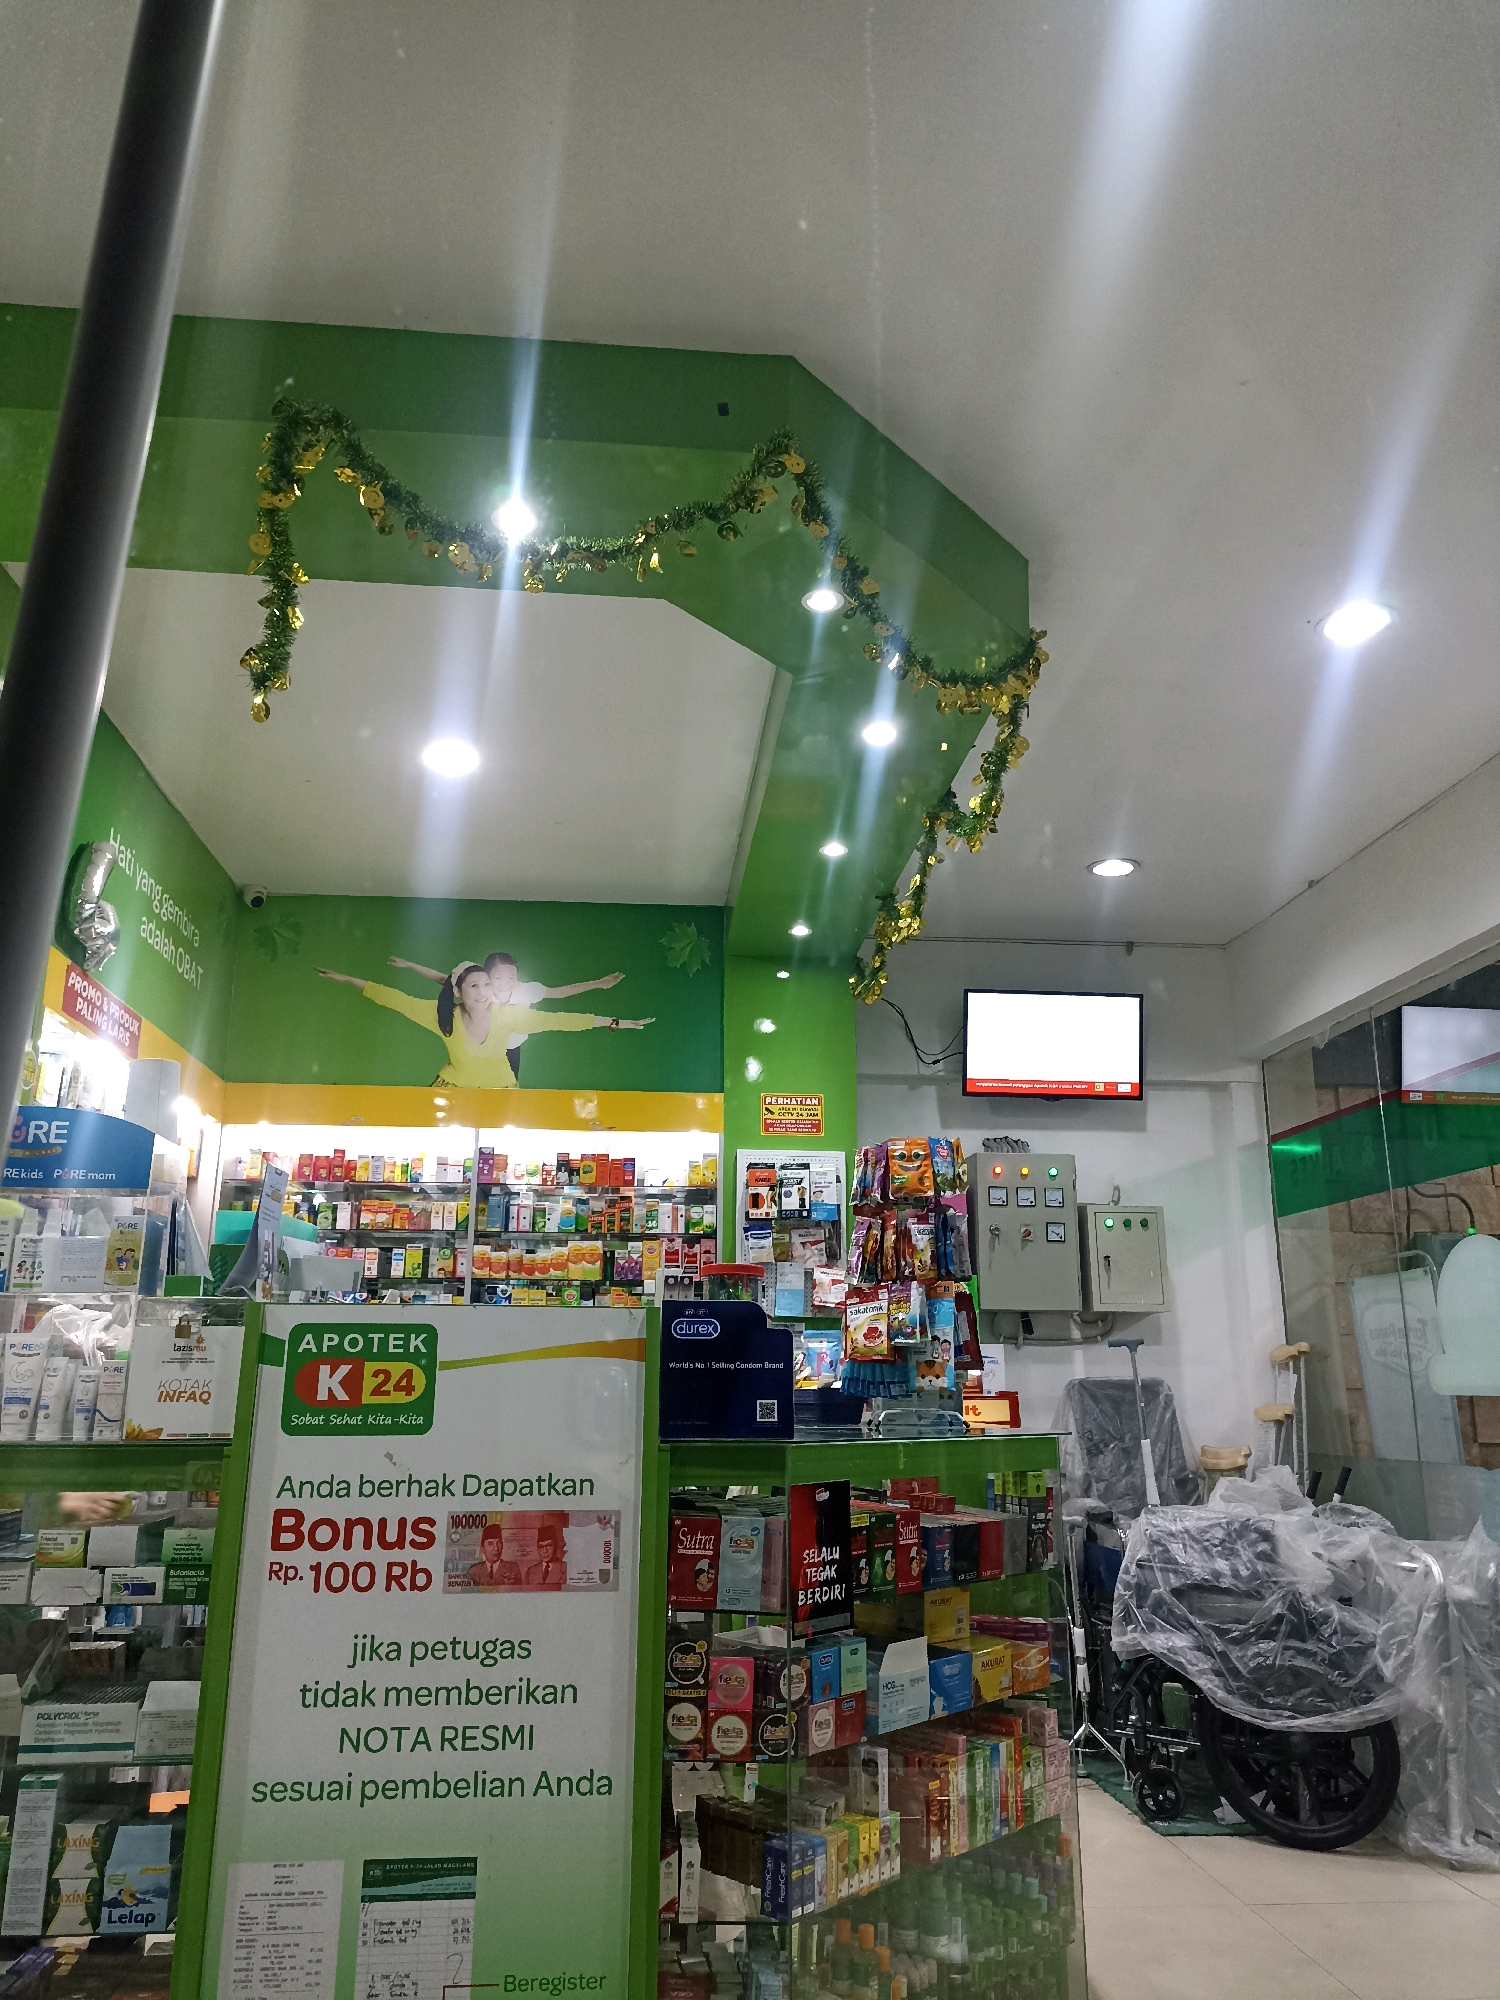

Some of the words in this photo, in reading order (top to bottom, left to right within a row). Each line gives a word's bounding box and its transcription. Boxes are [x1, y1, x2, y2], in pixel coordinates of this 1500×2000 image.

[109, 827, 136, 877] Hati
[135, 866, 163, 913] yang
[160, 892, 200, 948] gembira
[140, 916, 176, 967] adalah
[176, 950, 204, 991] OBAT
[67, 971, 102, 1008] PROMO
[109, 1002, 140, 1036] PRODUK
[75, 1000, 108, 1031] PALING
[108, 1020, 131, 1048] LARIS
[765, 1096, 819, 1105] PERHATIAN
[10, 1115, 70, 1144] URE
[88, 1171, 116, 1181] mom
[849, 1303, 884, 1316] sakatonik
[676, 1321, 717, 1335] durex
[297, 1333, 428, 1353] APOTEK
[668, 1361, 694, 1369] World's
[711, 1361, 735, 1370] Selling
[735, 1361, 763, 1369] Condom
[764, 1361, 784, 1369] Brand
[158, 1378, 213, 1391] KOTAK
[316, 1364, 353, 1401] K
[369, 1368, 416, 1397] 24
[157, 1390, 212, 1405] INFAQ
[291, 1413, 325, 1426] Sobat
[329, 1413, 363, 1425] Sehat
[367, 1412, 424, 1425] Kita-Kita
[276, 1473, 352, 1499] Anda
[358, 1473, 456, 1499] berhak
[462, 1473, 595, 1502] Dapatkan
[270, 1508, 437, 1552] Bonus
[450, 1513, 488, 1529] 100000
[677, 1527, 715, 1550] Sutra
[802, 1546, 840, 1564] SELALU
[268, 1562, 304, 1585] Rp.
[309, 1561, 377, 1594] 100
[384, 1559, 433, 1593] Rb
[805, 1565, 838, 1583] TEGAK
[797, 1583, 846, 1607] BERDIRI
[347, 1634, 402, 1669] jika
[409, 1636, 533, 1668] petugas
[672, 1652, 702, 1664] fiesta
[717, 1672, 746, 1684] fiesta
[299, 1680, 376, 1709] tidak
[383, 1678, 579, 1707] memberikan
[36, 1711, 81, 1720] POLYCROL
[671, 1713, 698, 1723] fiesta
[338, 1726, 433, 1754] NOTA
[439, 1724, 535, 1752] RESMI
[716, 1725, 744, 1735] fiesta
[251, 1772, 353, 1803] sesuai
[359, 1770, 526, 1808] pembelian
[532, 1768, 614, 1798] Anda
[764, 1856, 772, 1897] FreshCare
[778, 1862, 786, 1903] FreshCare
[107, 1909, 157, 1927] Lelap
[503, 1972, 607, 1997] Beregister
